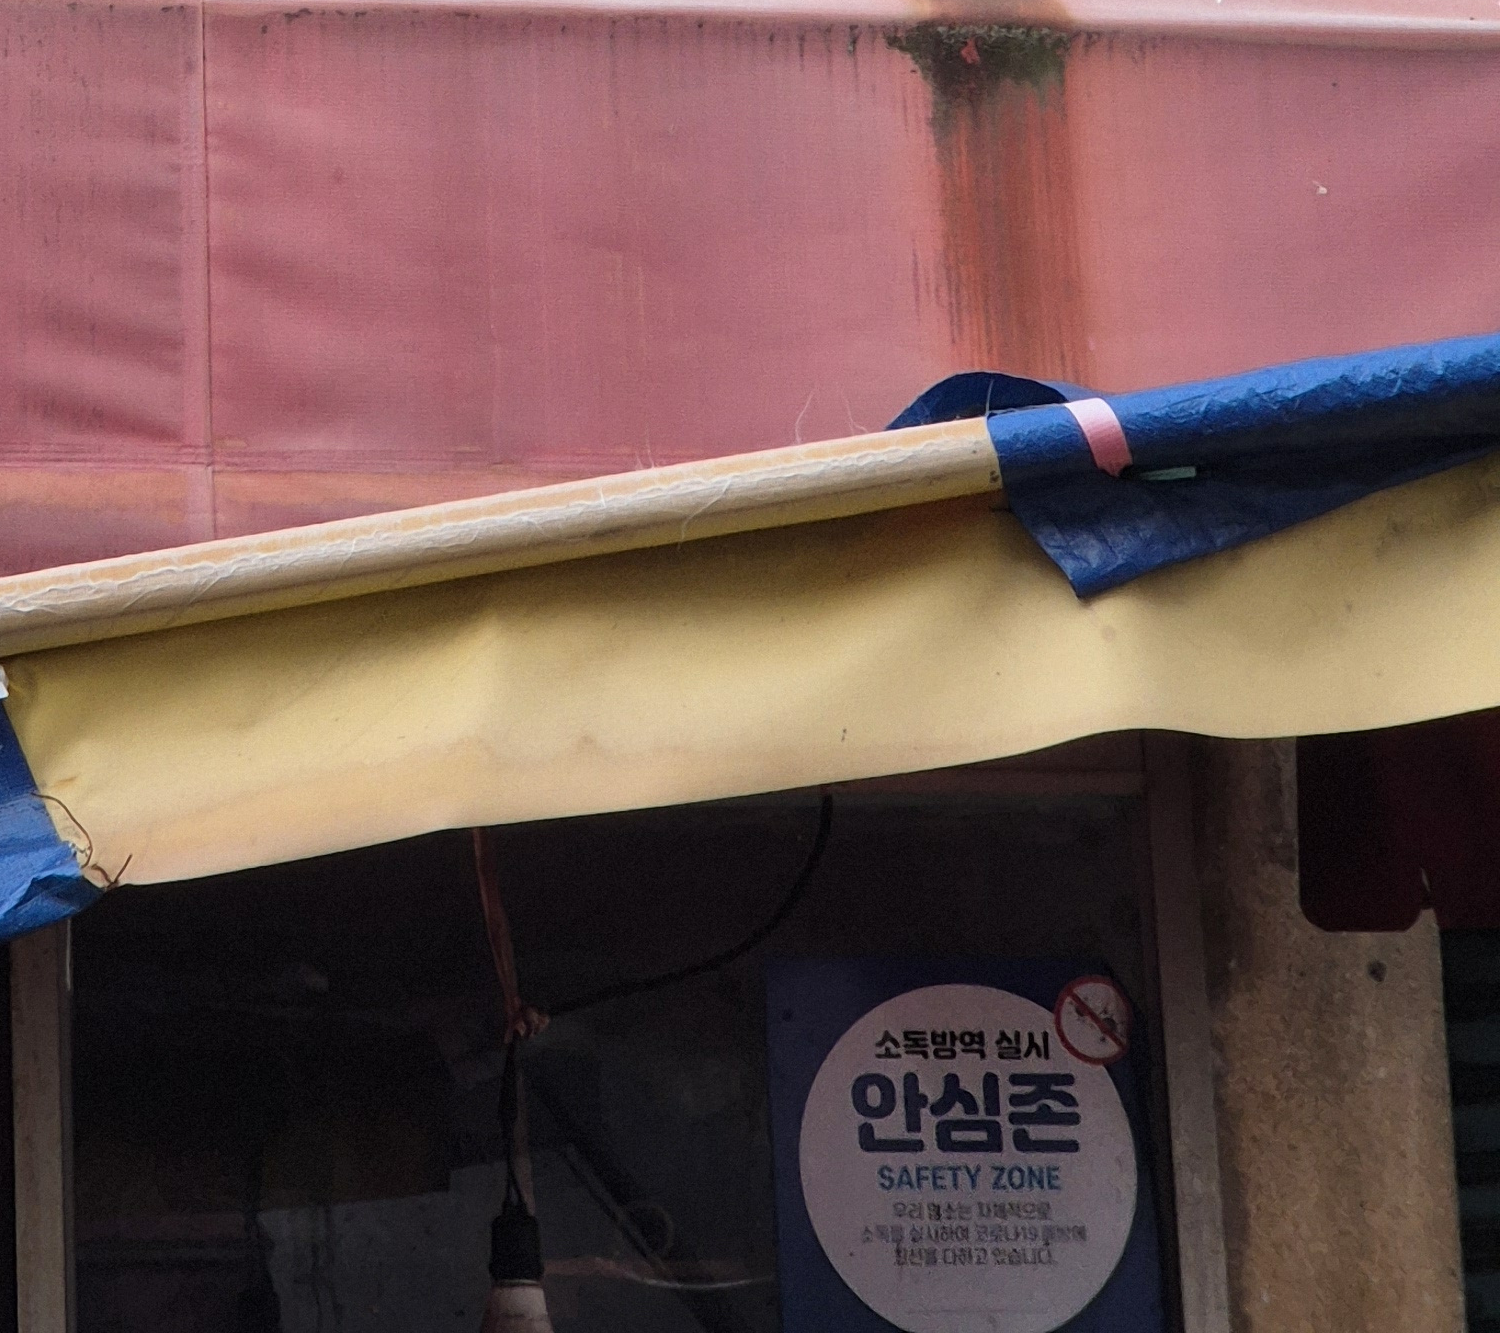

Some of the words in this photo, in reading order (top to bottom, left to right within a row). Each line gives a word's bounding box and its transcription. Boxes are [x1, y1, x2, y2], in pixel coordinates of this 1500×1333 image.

[874, 1029, 987, 1061] 소독방역
[994, 1029, 1051, 1061] 실시
[850, 1071, 1082, 1154] 안심존
[877, 1163, 982, 1191] SAFETY
[991, 1164, 1062, 1191] ZONE
